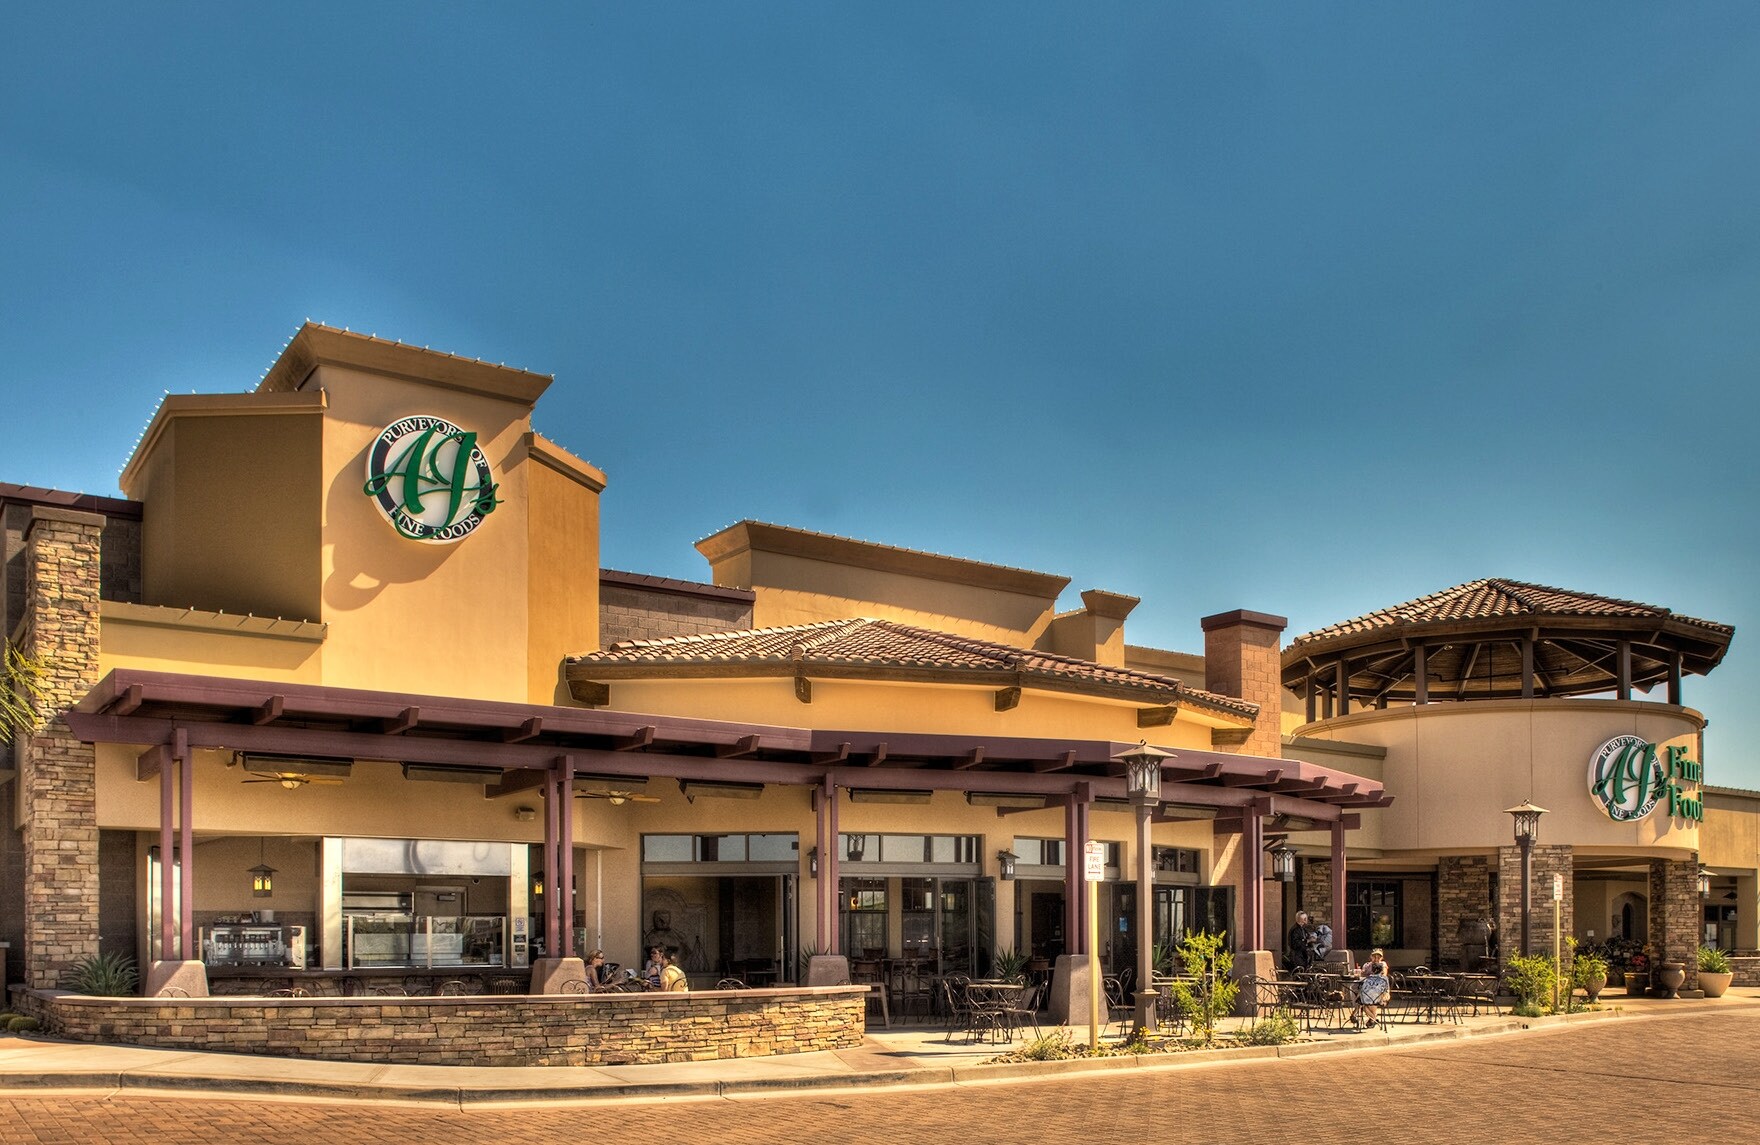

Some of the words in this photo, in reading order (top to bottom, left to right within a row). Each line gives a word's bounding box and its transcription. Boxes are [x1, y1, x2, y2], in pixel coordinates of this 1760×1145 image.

[381, 418, 465, 446] PURVEYORS
[471, 448, 487, 468] OF
[388, 505, 425, 536] FINE
[431, 513, 480, 540] FOODS
[1604, 799, 1624, 818] FNE
